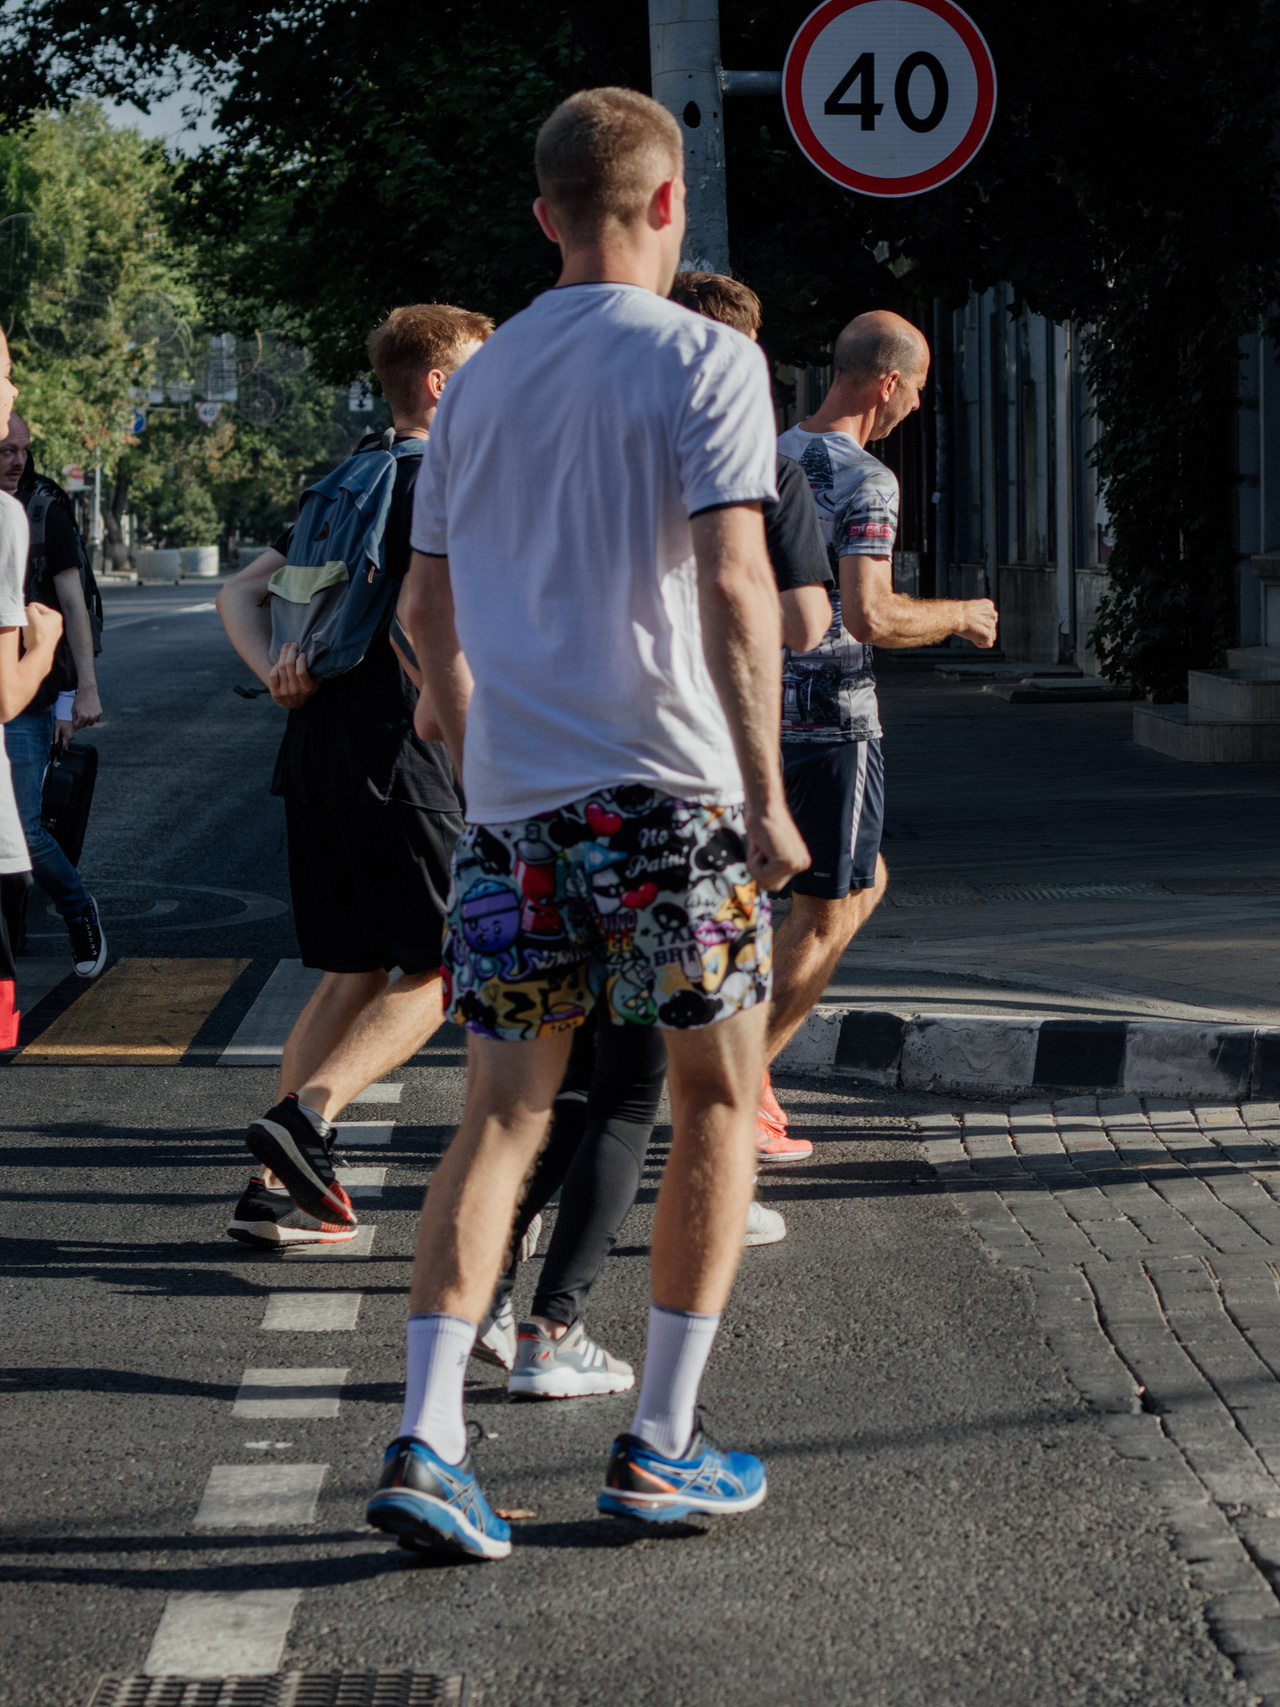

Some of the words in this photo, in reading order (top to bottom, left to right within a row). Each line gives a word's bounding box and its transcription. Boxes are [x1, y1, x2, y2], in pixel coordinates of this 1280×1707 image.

[824, 51, 949, 133] 40
[202, 407, 216, 416] 40
[638, 827, 670, 850] No
[625, 844, 689, 879] Pain!
